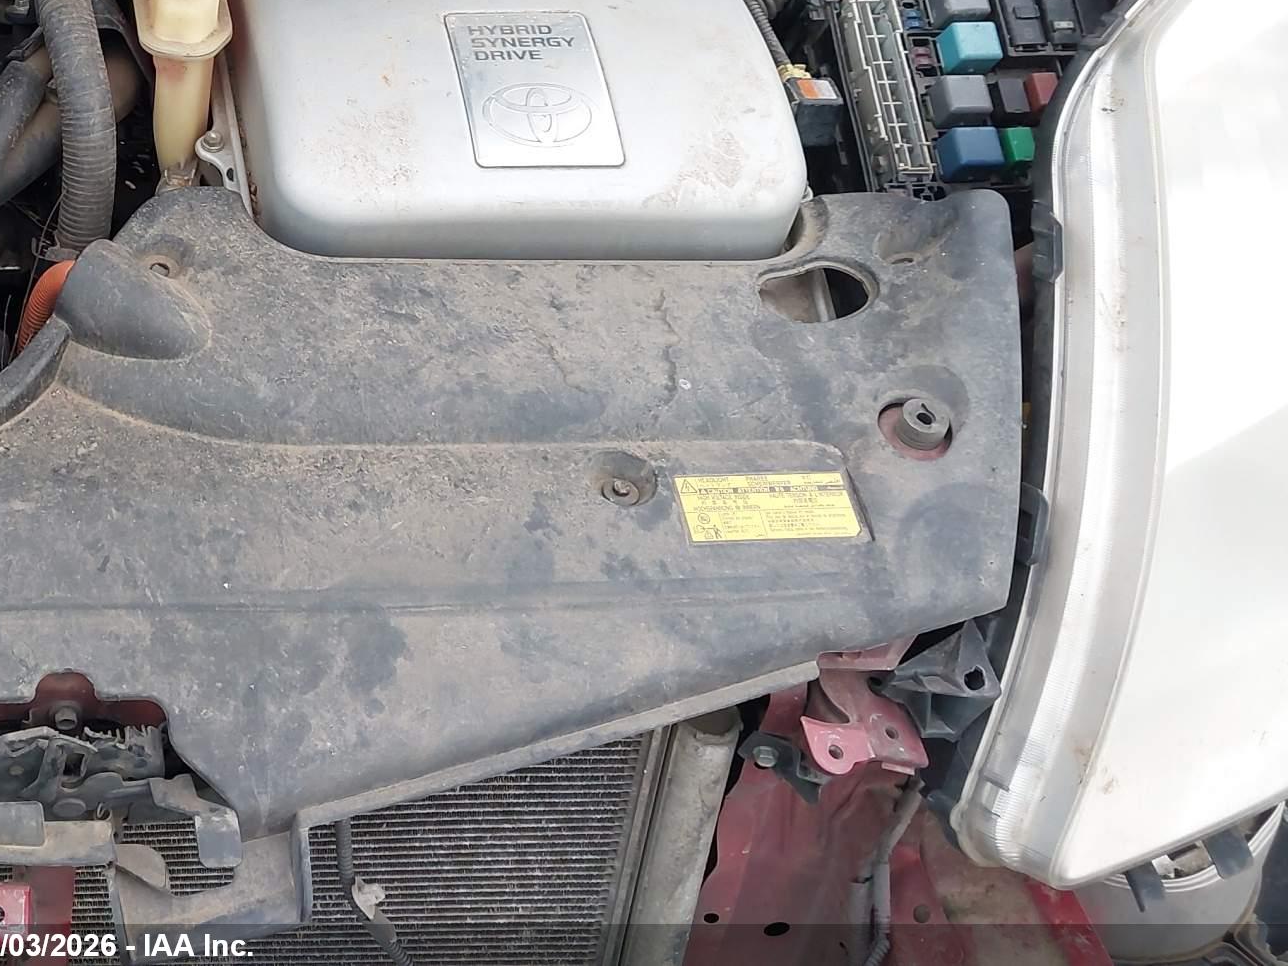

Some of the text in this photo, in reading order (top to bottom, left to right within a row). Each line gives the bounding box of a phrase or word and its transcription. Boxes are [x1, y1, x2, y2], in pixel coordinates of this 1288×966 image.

[466, 24, 553, 35] HYBRID
[471, 36, 575, 48] SYNERGY
[473, 49, 544, 61] DRIVE
